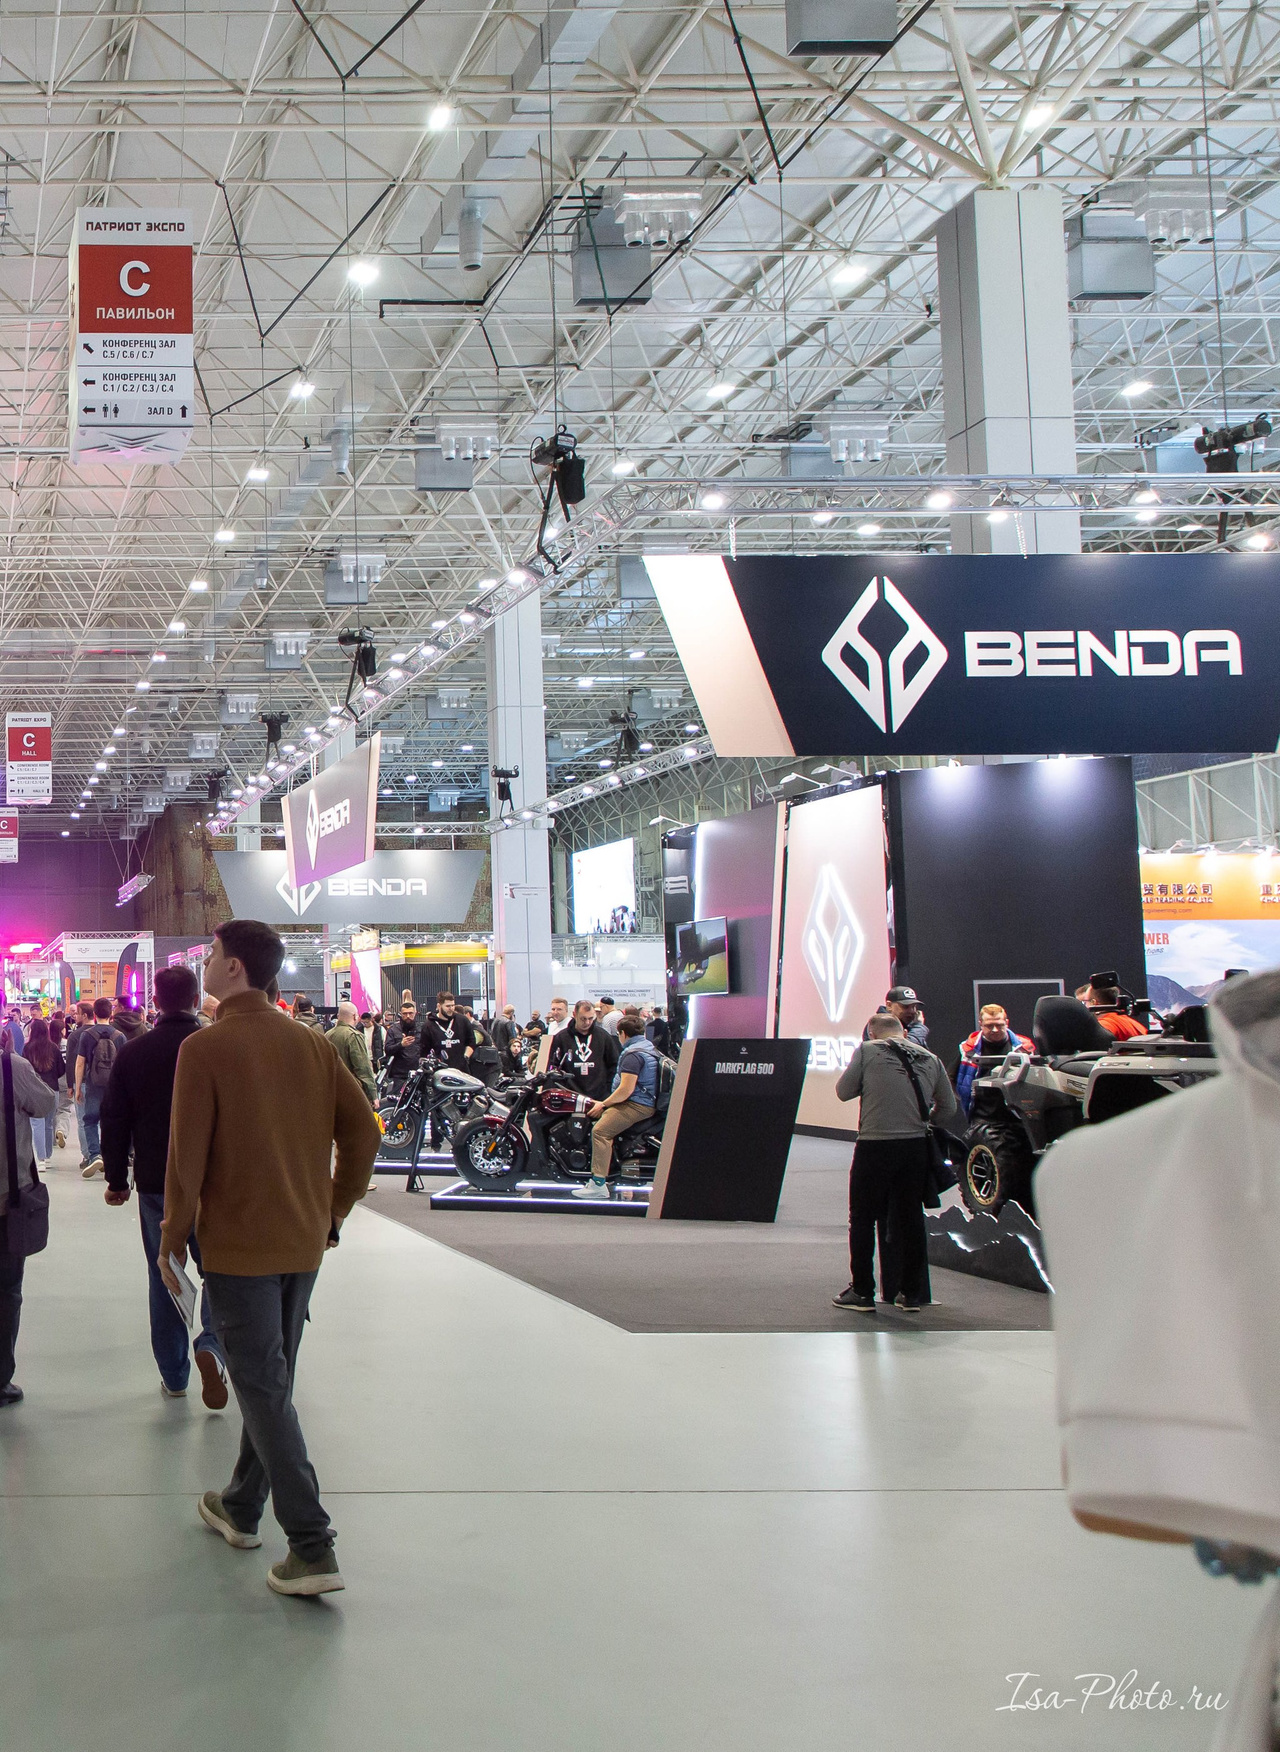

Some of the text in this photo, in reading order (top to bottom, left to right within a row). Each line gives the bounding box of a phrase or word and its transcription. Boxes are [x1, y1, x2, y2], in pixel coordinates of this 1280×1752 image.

[86, 222, 185, 231] ПАТРИОТ ЭКСПО
[119, 260, 151, 297] C
[96, 307, 175, 320] ПАВИЛЬОН
[102, 339, 176, 349] КОНФЕРЕНЦ ЗАЛ
[102, 373, 176, 382] КОНФЕРЕНЦ ЗАЛ
[147, 407, 164, 415] ЗАЛ
[963, 629, 1243, 677] BENDA
[22, 732, 36, 748] C
[0, 820, 8, 829] C
[320, 798, 350, 838] BENDA
[327, 878, 427, 896] BENDA
[715, 1062, 775, 1075] DARKFLAG 500
